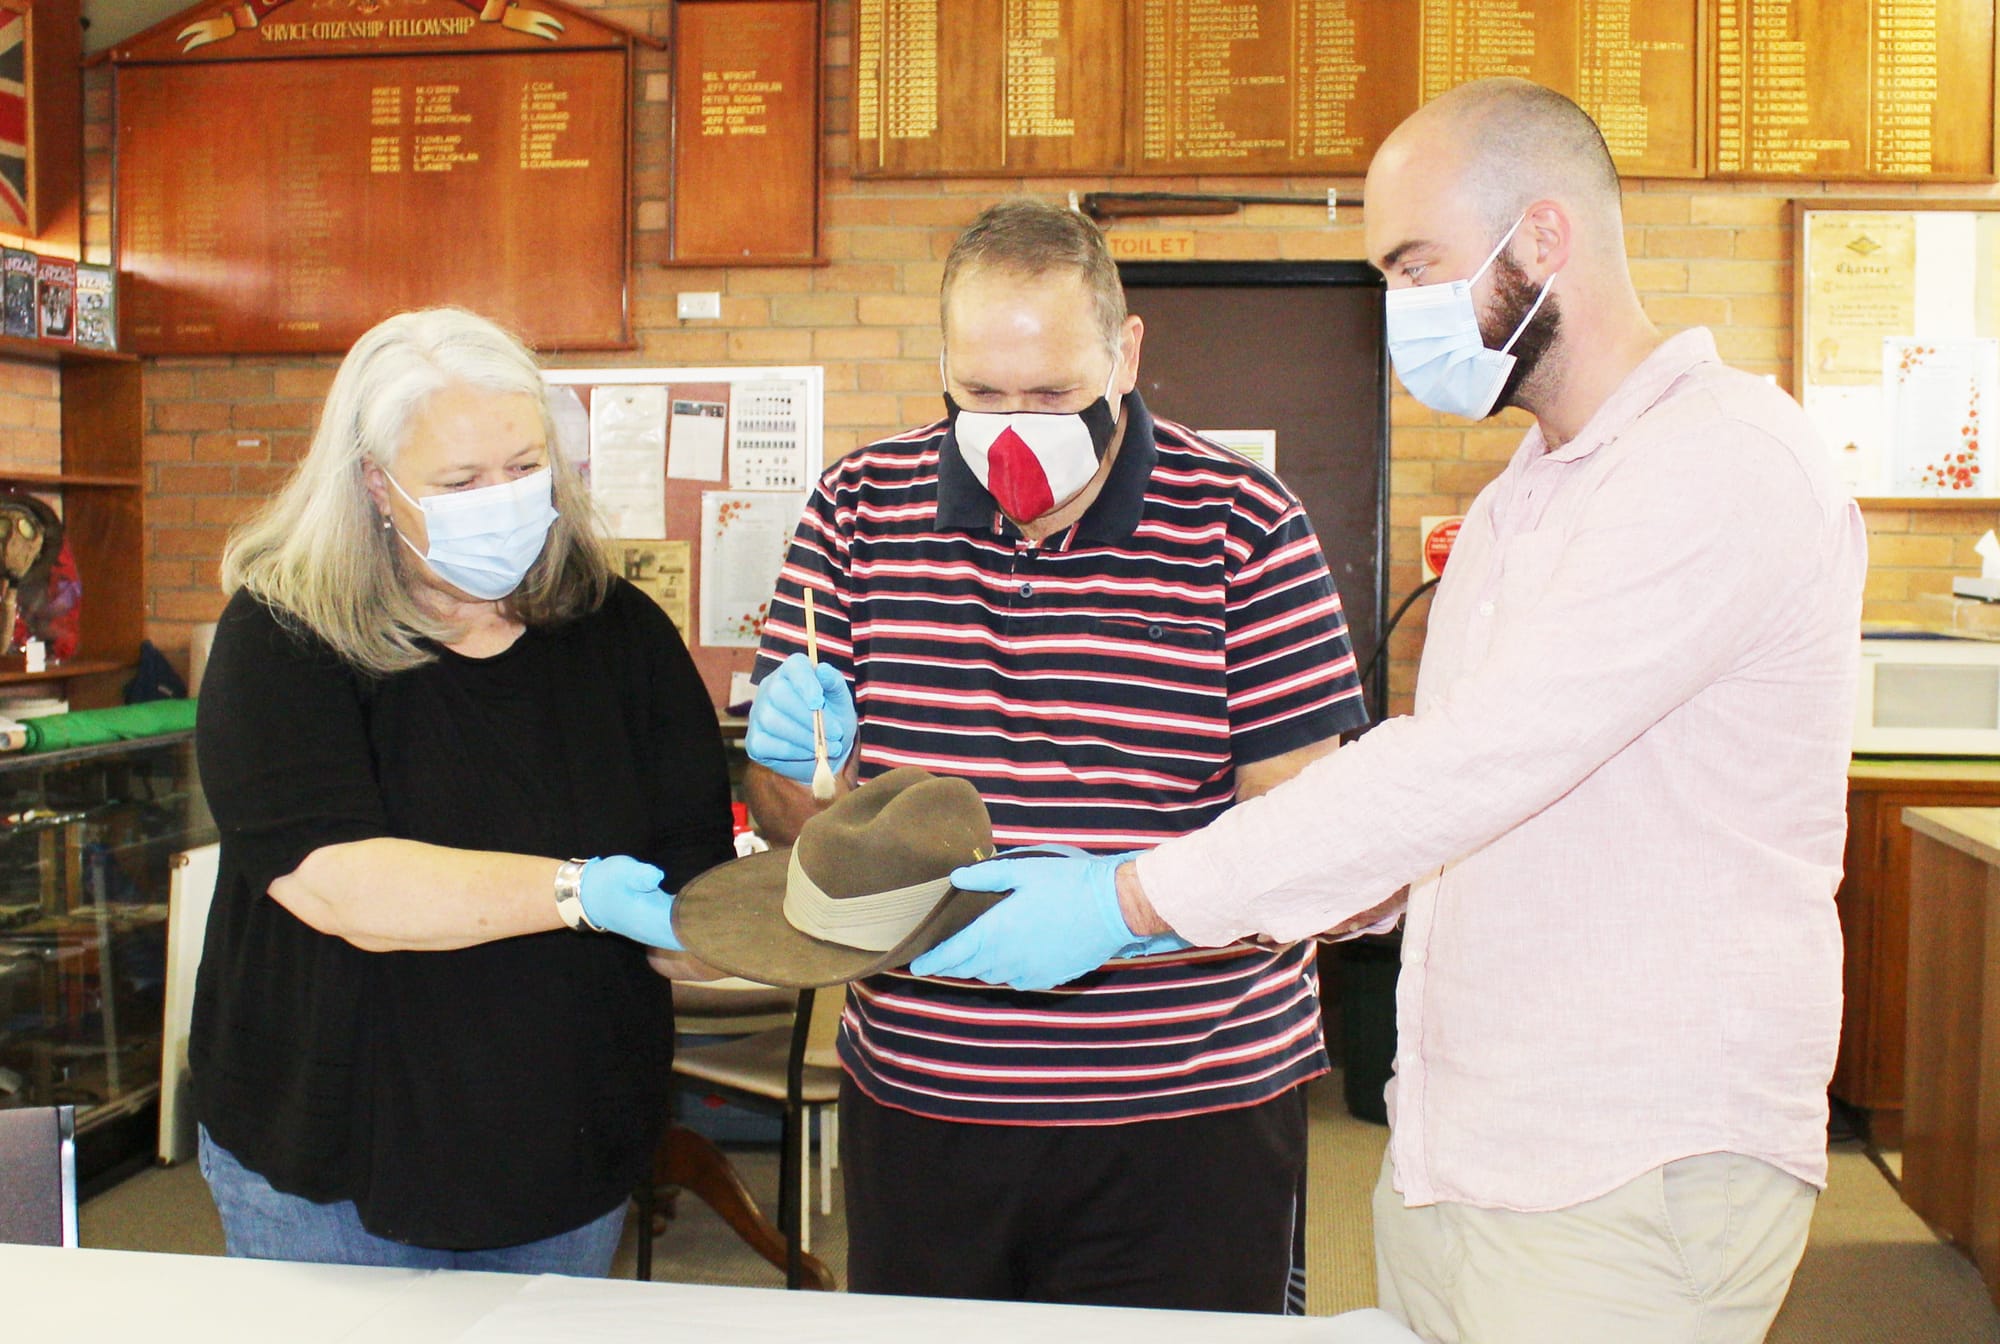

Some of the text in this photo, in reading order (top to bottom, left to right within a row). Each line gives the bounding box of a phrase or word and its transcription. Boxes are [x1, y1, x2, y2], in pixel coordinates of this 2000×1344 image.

[261, 16, 475, 41] SERVICE CITIZENSHIP FELLOWSHIP
[1110, 237, 1189, 254] TOILET
